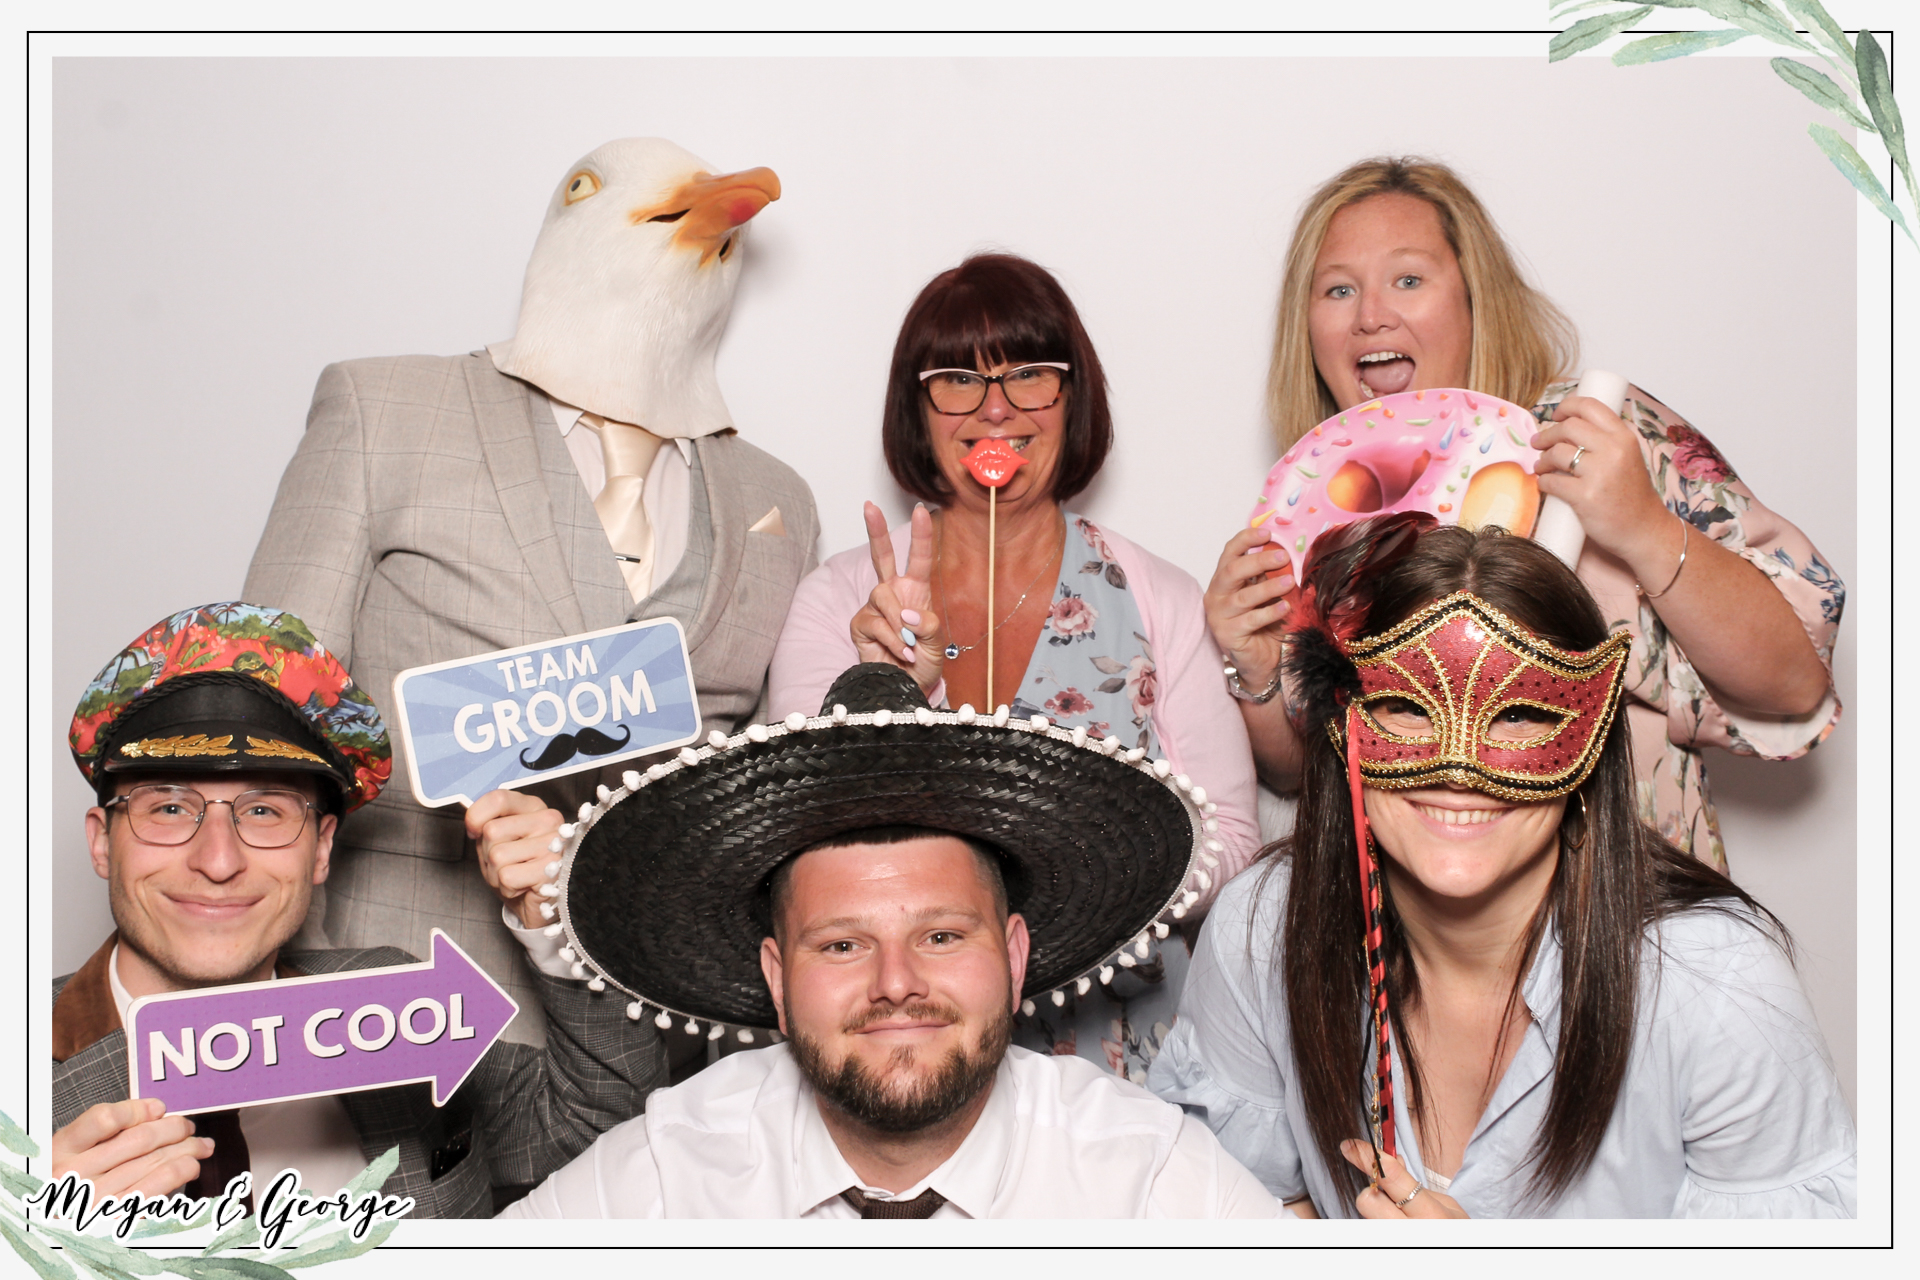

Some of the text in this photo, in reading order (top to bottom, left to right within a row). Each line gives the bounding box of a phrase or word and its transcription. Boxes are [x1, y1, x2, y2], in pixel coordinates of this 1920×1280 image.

[497, 644, 598, 693] TEAM
[453, 669, 657, 753] GROOM
[149, 1015, 285, 1082] NOT
[303, 993, 475, 1060] COOL
